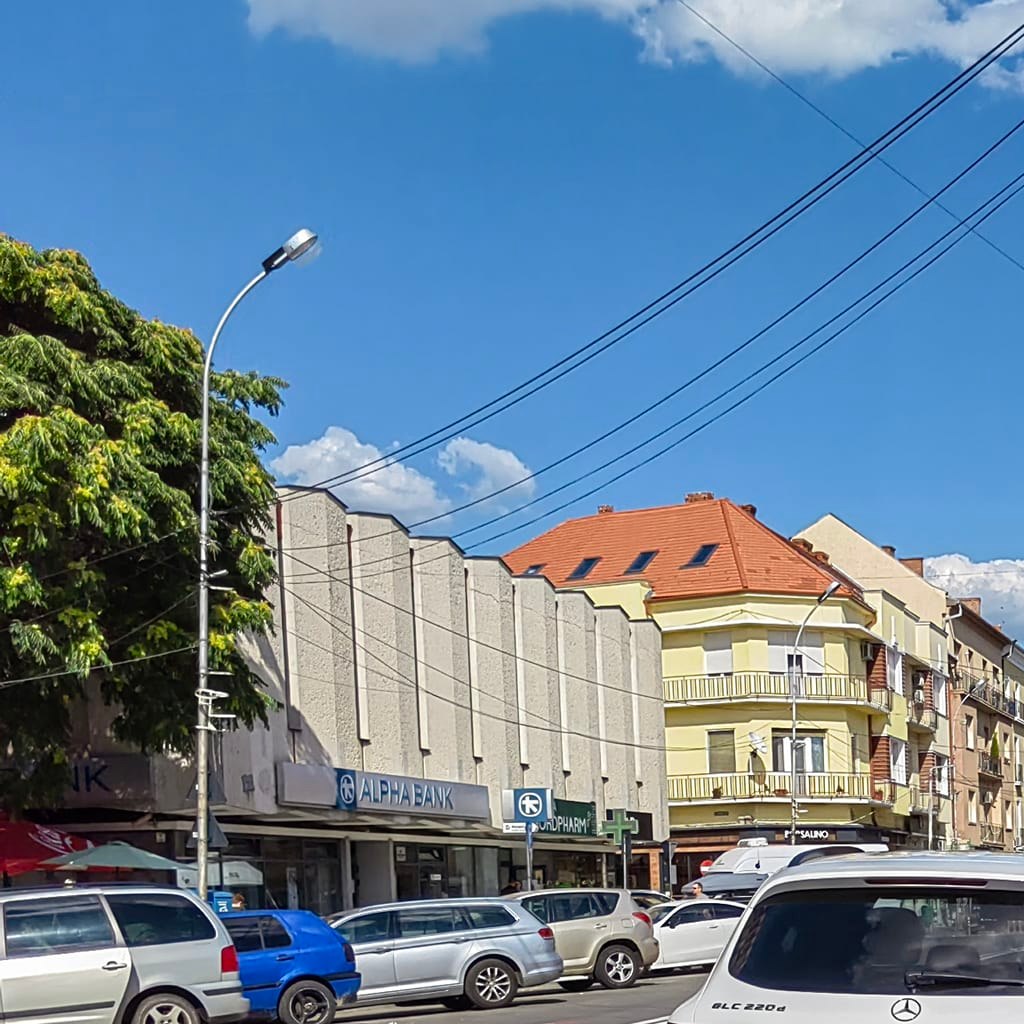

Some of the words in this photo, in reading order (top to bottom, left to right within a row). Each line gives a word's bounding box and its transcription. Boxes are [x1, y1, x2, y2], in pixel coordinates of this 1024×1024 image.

[359, 777, 410, 806] ALPHA
[412, 783, 454, 809] BANK
[537, 815, 587, 834] ORDPHARM
[711, 1002, 742, 1010] GLC
[743, 1003, 787, 1012] 220d
